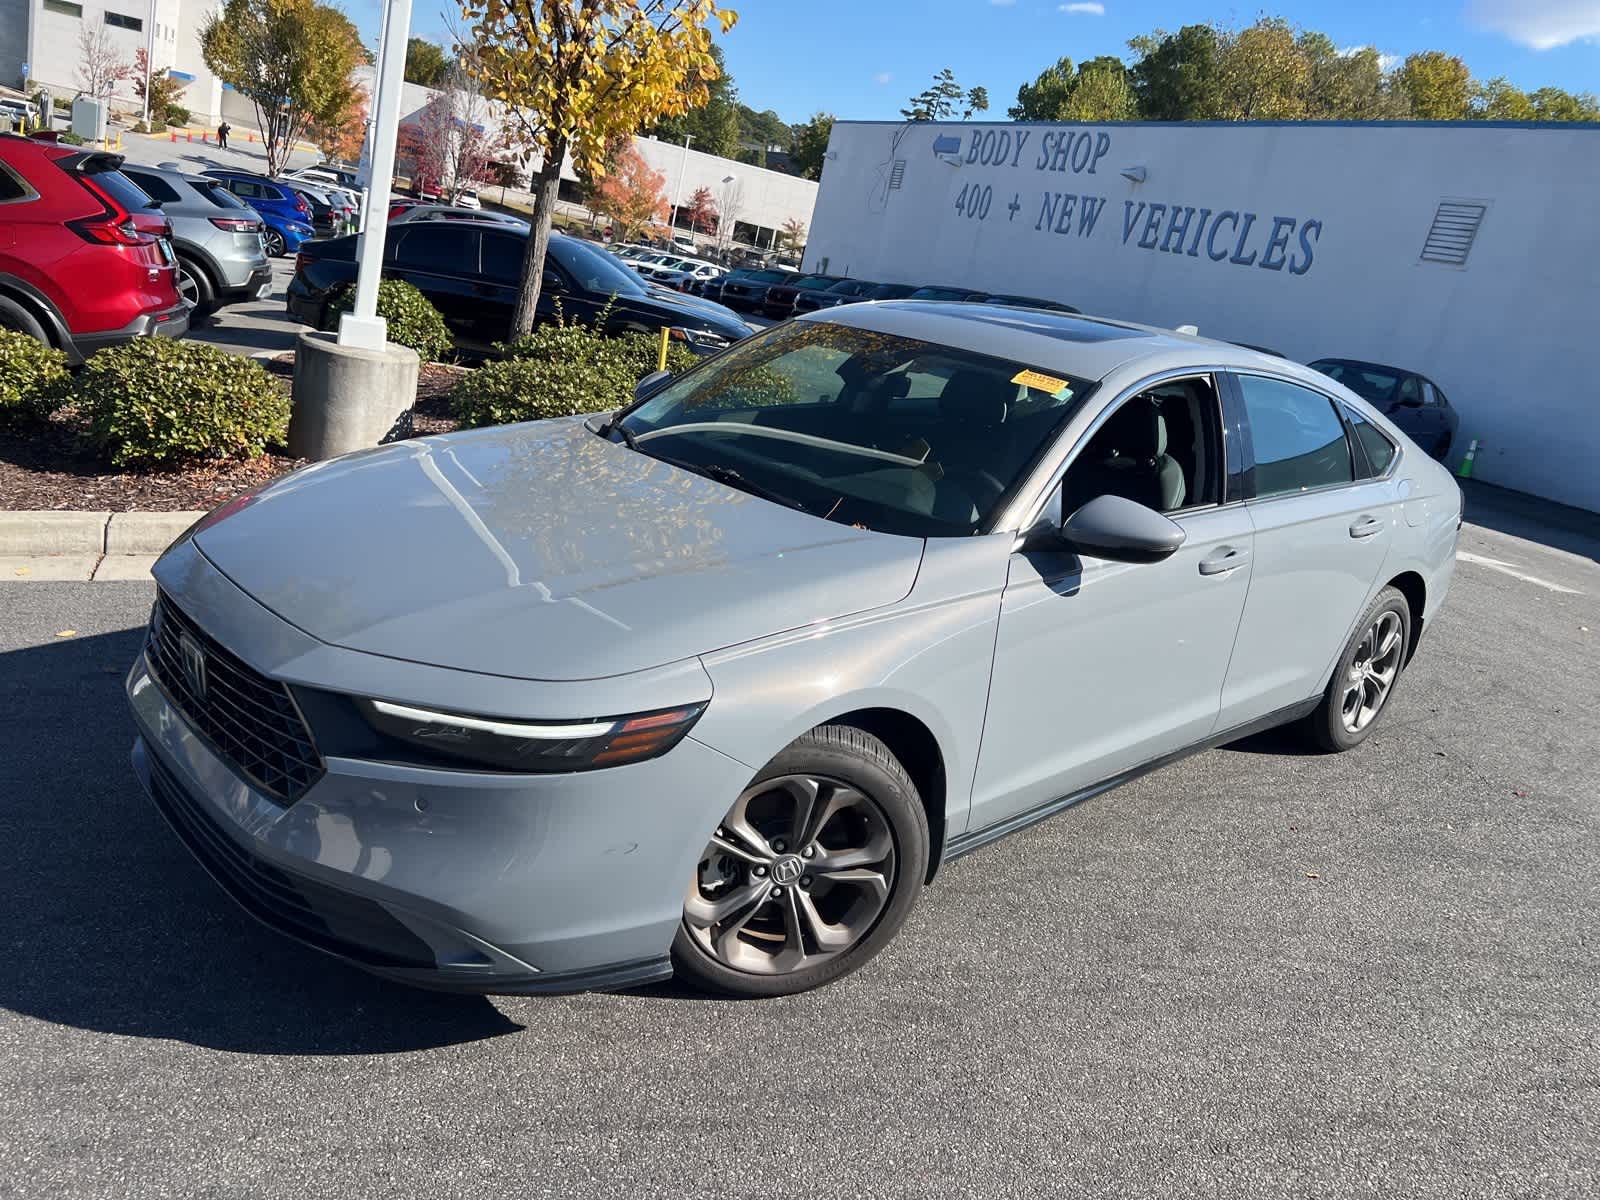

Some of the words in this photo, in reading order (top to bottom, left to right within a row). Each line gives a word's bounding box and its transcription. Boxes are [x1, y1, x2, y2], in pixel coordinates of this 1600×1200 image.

[965, 129, 1031, 168] BODY
[1036, 131, 1111, 174] SHOP
[955, 182, 993, 220] 400
[1035, 191, 1107, 238] NEW
[1122, 200, 1323, 275] VEHICLES
